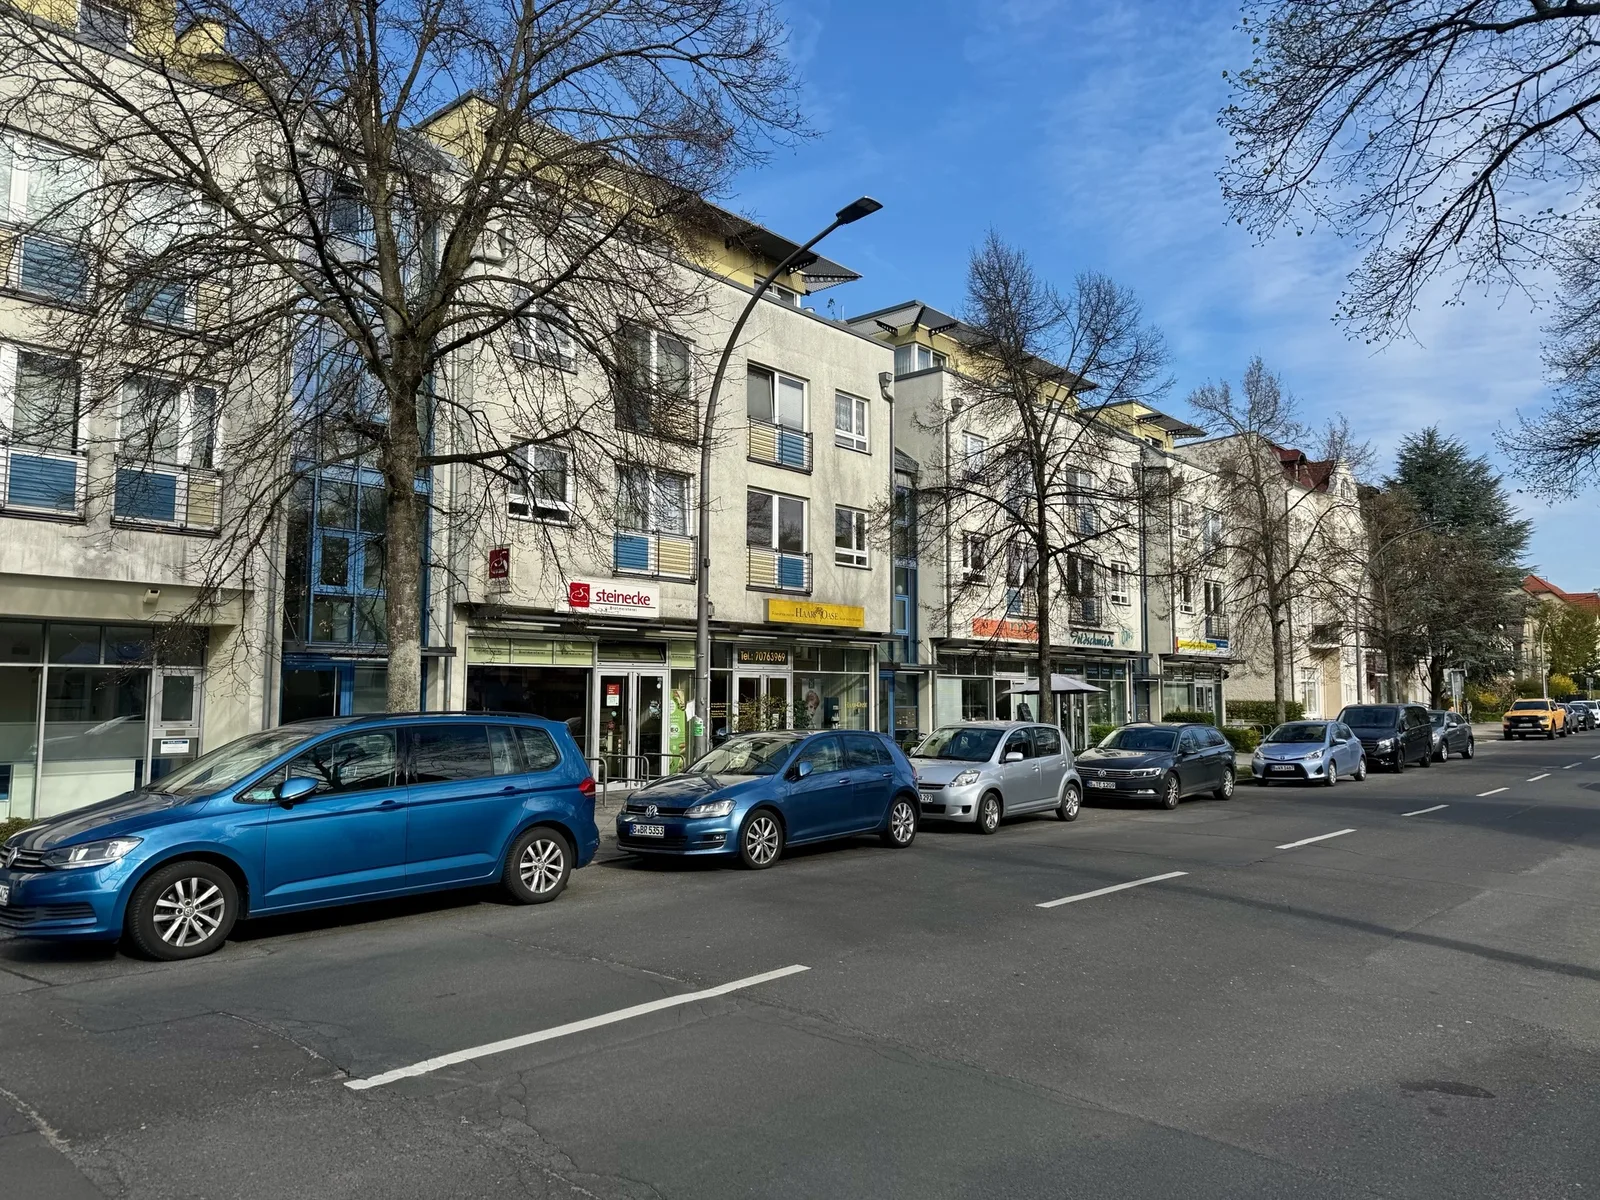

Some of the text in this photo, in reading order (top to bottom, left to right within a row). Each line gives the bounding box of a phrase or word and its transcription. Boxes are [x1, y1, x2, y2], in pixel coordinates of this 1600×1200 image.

[595, 589, 651, 605] steinecke
[795, 607, 816, 619] HAAR
[821, 609, 839, 620] OASE
[755, 651, 786, 662] 70763969
[648, 826, 664, 835] 5353
